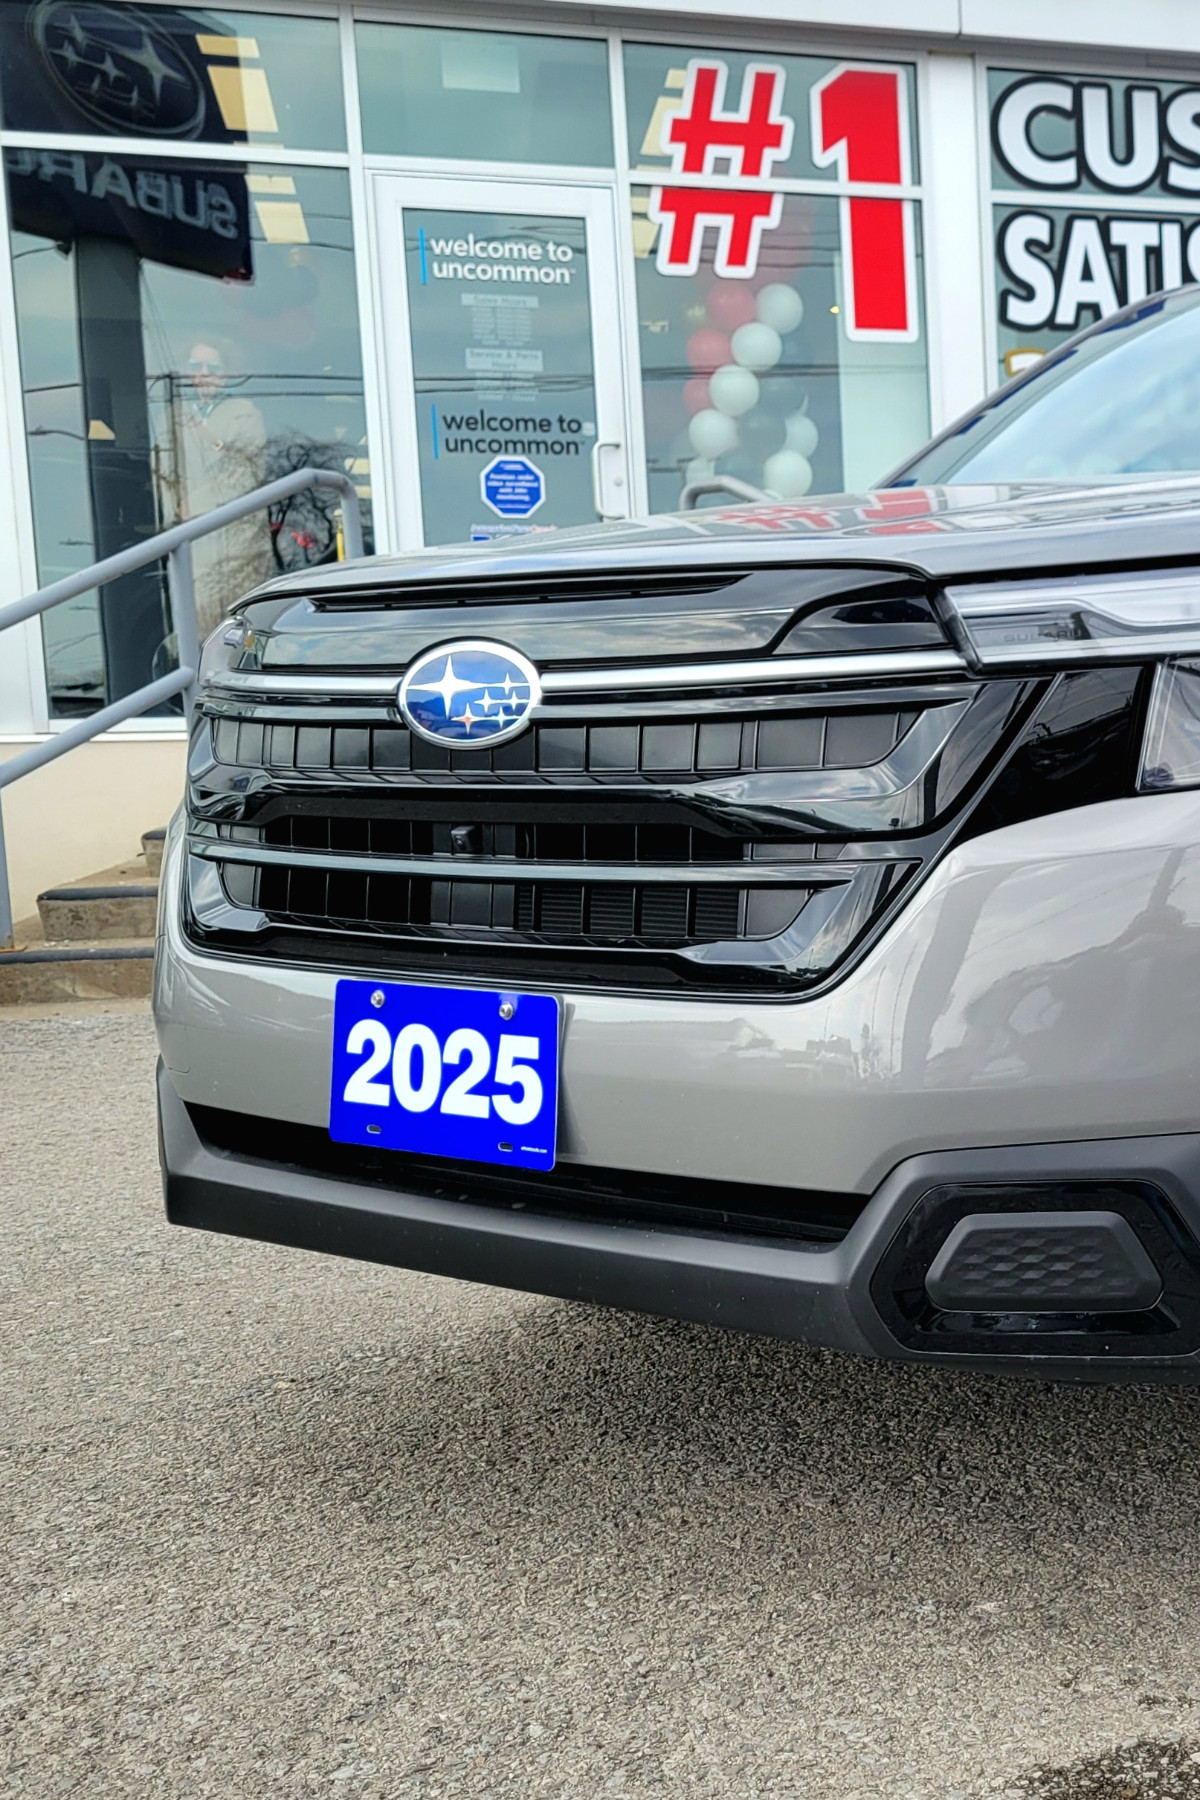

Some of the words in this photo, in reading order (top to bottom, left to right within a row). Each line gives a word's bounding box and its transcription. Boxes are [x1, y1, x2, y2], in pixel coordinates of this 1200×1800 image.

[648, 58, 919, 343] #1
[430, 233, 543, 261] welcome
[546, 241, 573, 262] to
[442, 409, 552, 433] welcome
[556, 414, 582, 434] to
[343, 1018, 543, 1125] 2025
